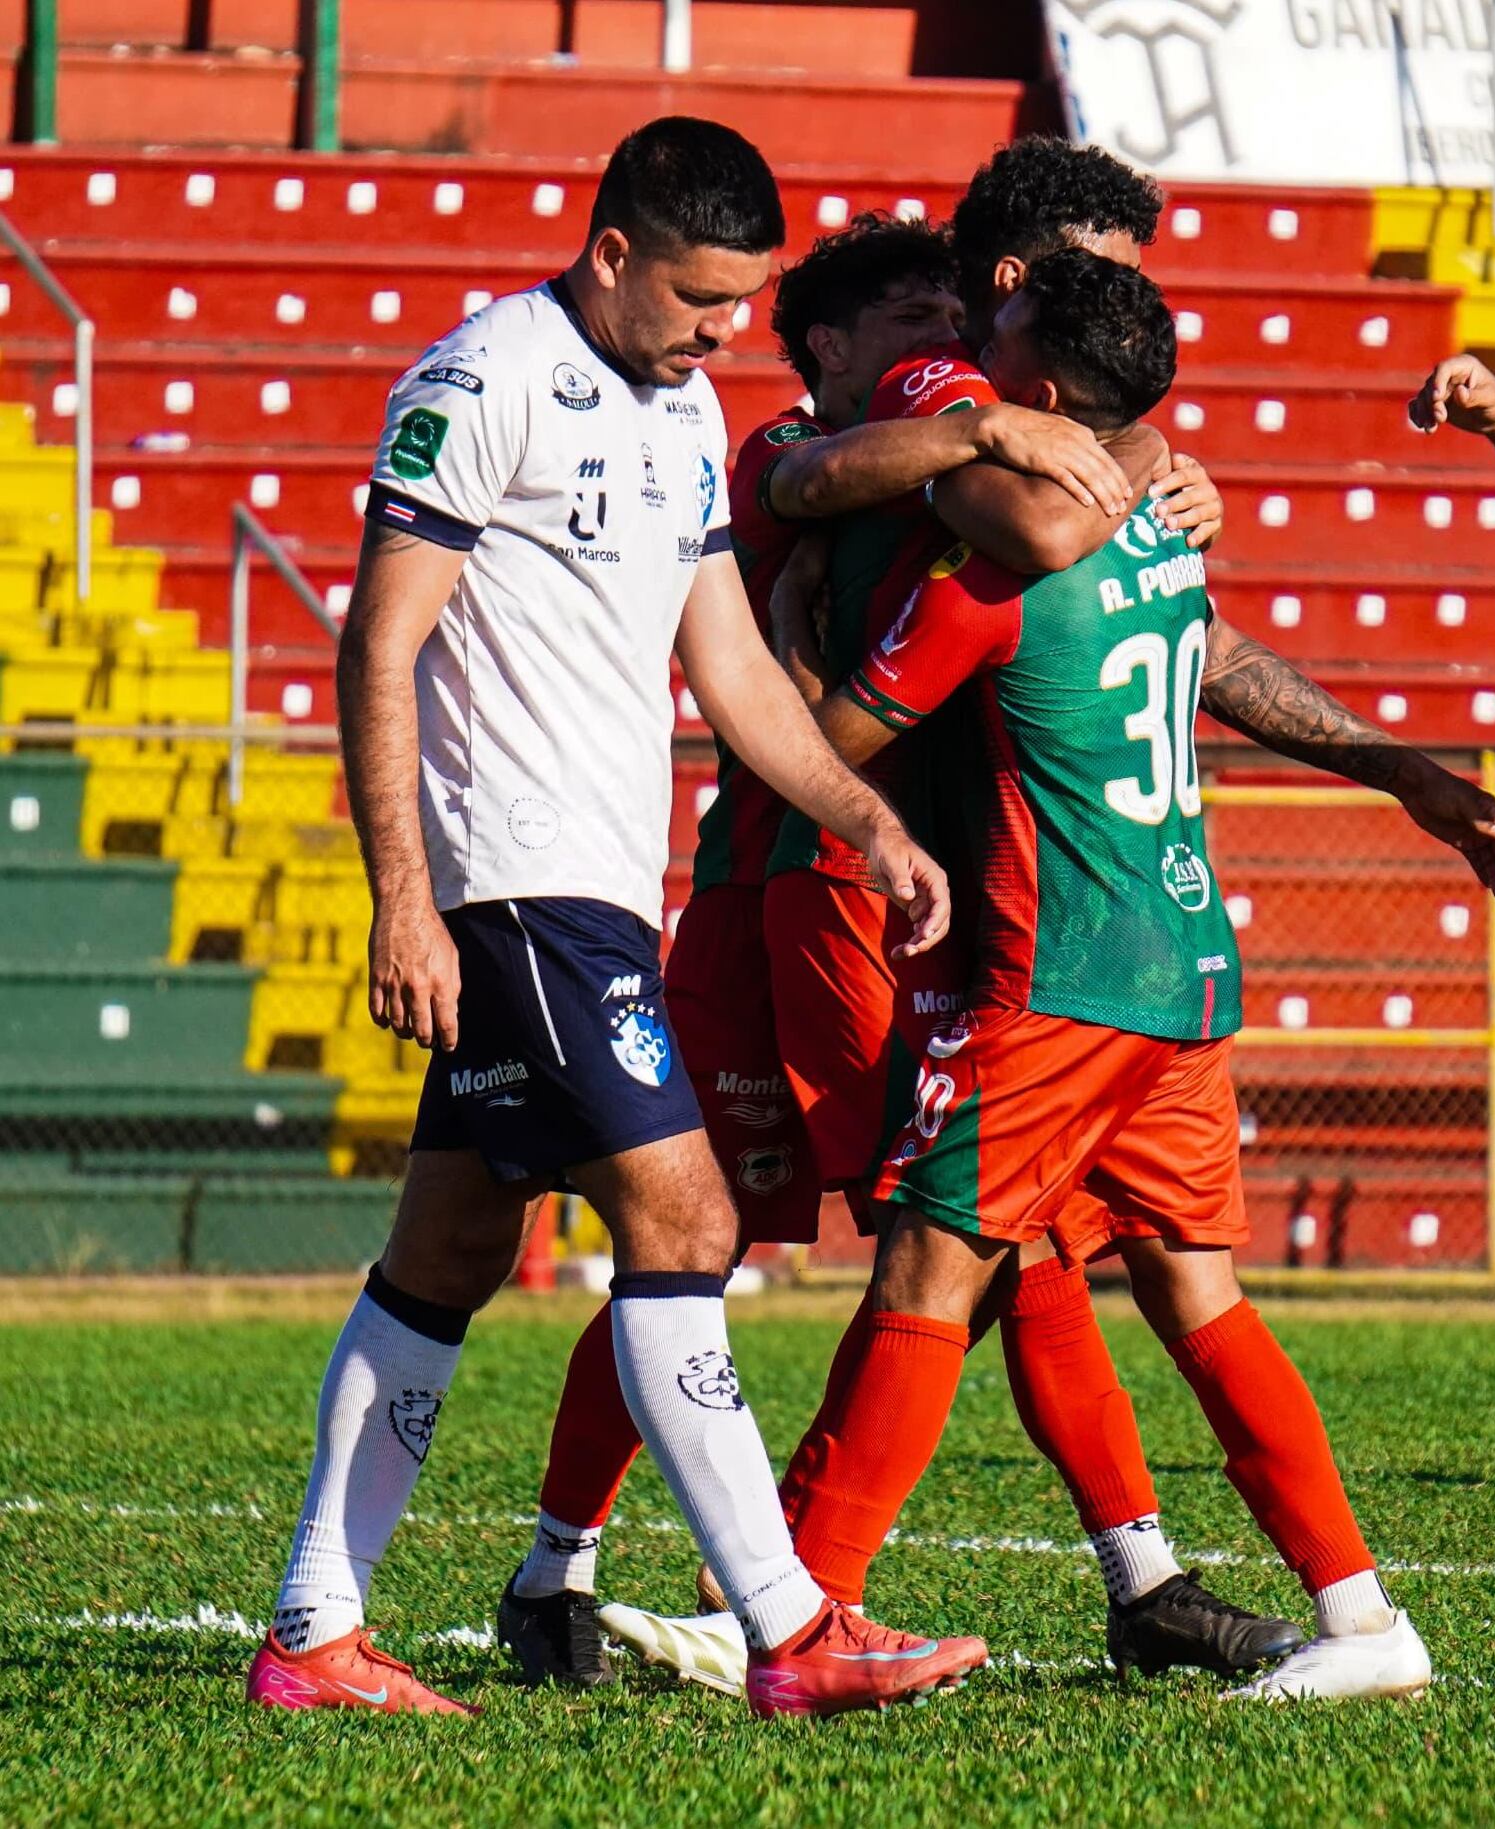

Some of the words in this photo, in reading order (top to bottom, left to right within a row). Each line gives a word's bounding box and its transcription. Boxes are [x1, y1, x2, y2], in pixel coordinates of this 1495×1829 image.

[448, 371, 479, 389] BUS
[578, 547, 621, 563] Marcos
[1100, 618, 1207, 825] 30
